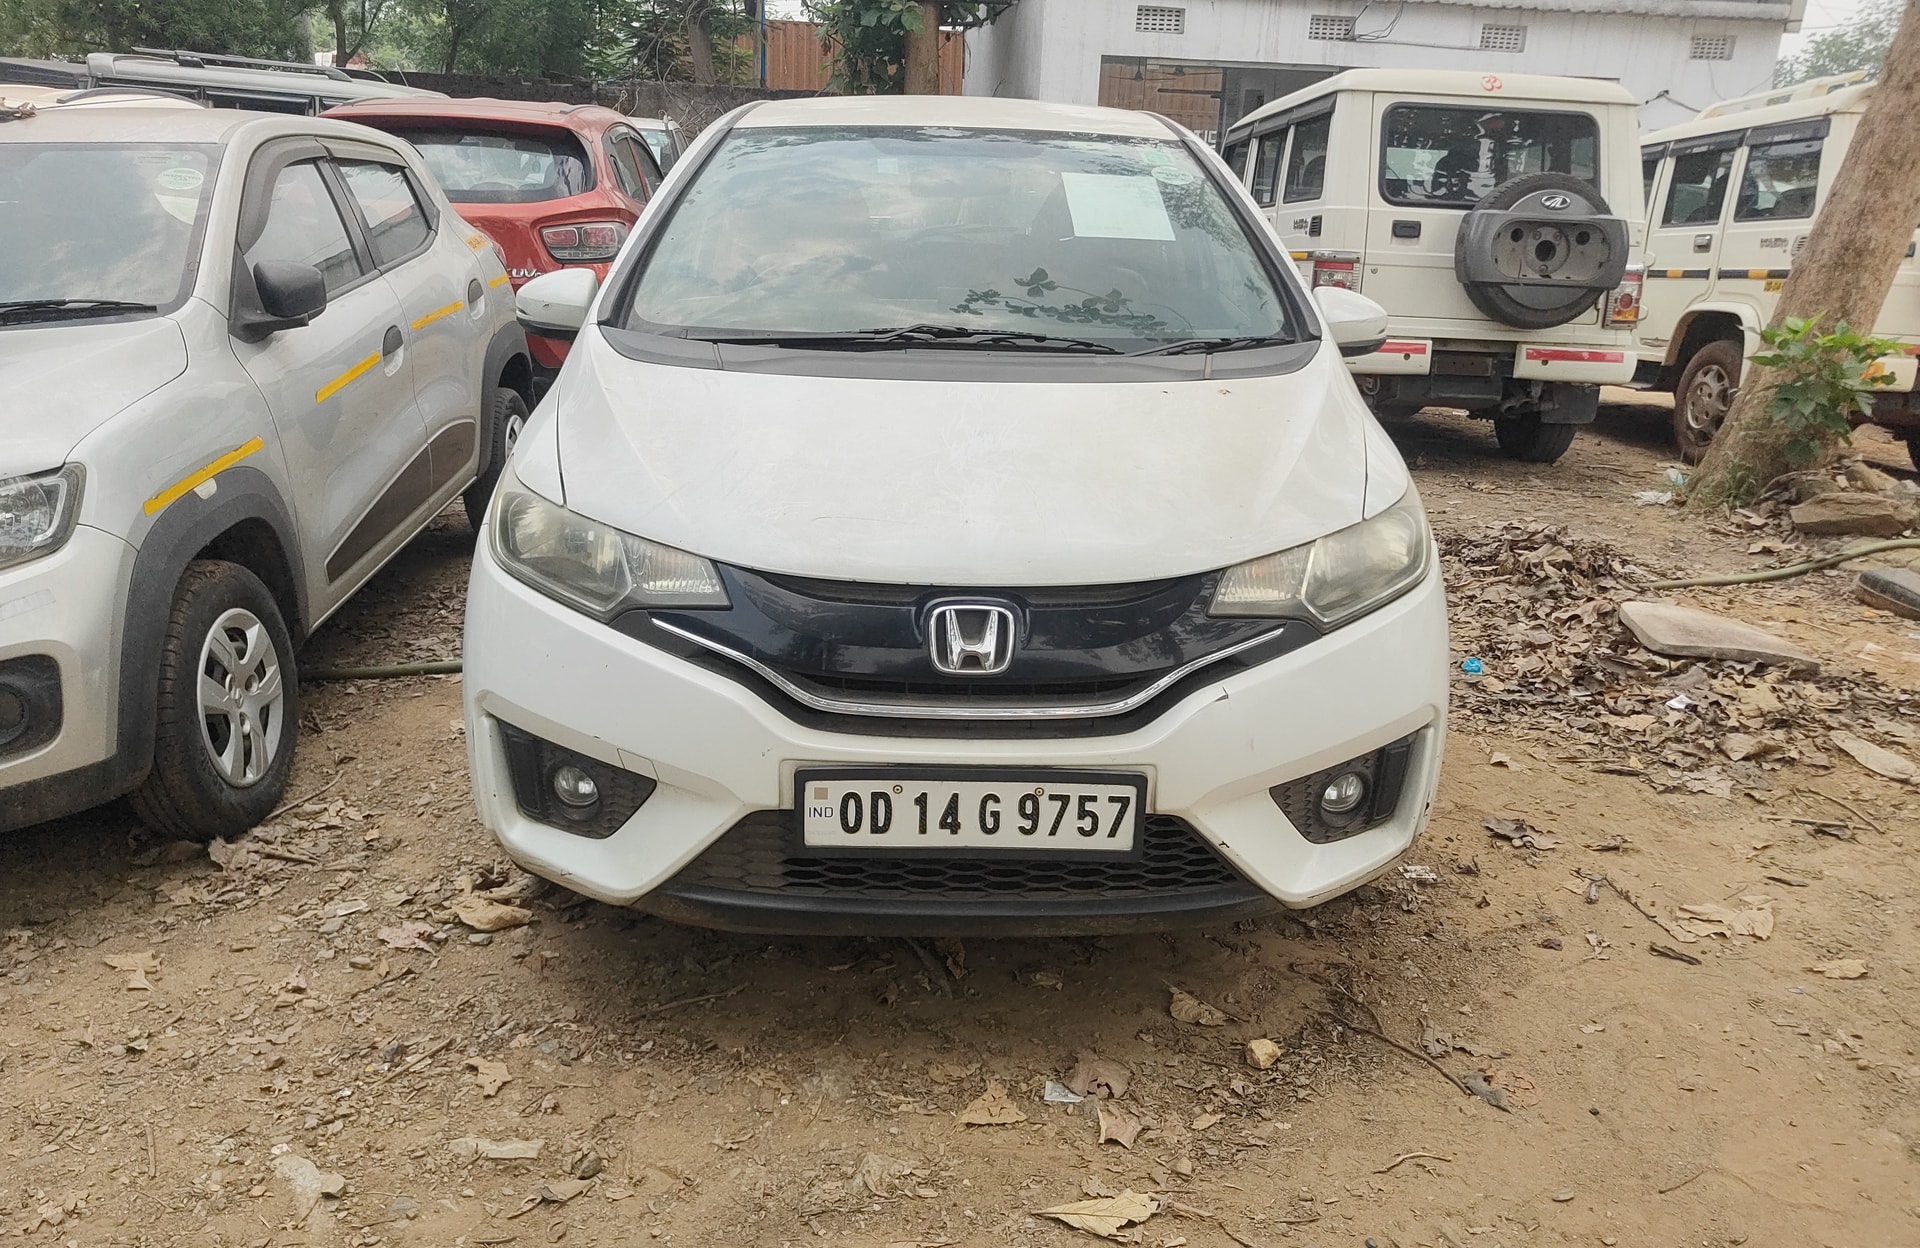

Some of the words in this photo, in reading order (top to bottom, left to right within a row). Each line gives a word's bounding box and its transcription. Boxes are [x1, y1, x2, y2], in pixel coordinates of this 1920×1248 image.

[808, 806, 834, 819] IND
[839, 791, 893, 835] OD
[913, 791, 962, 836] 14
[978, 793, 1002, 836] G
[1017, 792, 1132, 839] 9757
